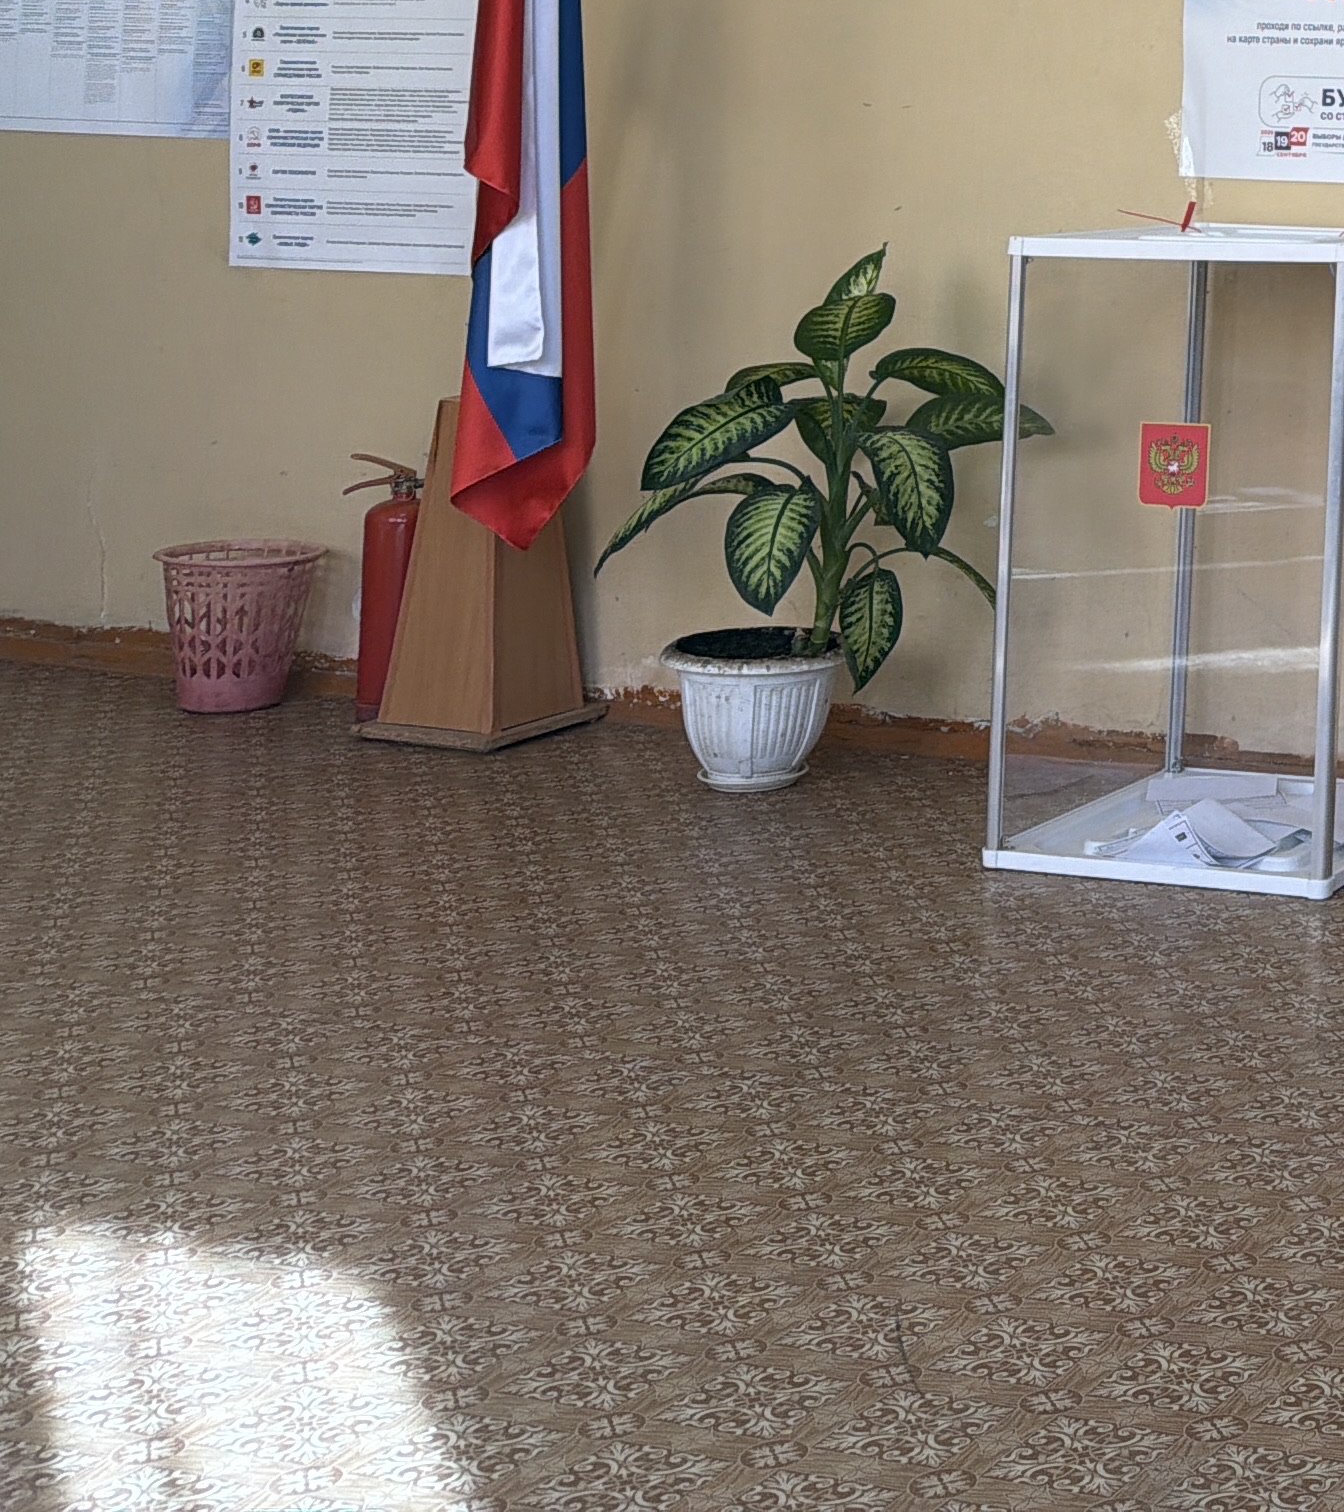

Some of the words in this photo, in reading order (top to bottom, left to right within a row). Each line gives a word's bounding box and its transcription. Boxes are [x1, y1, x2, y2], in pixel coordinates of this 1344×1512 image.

[1256, 22, 1290, 32] проходи
[1291, 23, 1302, 31] по
[1303, 24, 1335, 33] ссылке,
[1227, 35, 1237, 43] на
[1238, 36, 1261, 45] карте
[1261, 36, 1292, 46] страны
[1300, 37, 1334, 47] сохрани
[1320, 112, 1334, 122] СО
[1262, 141, 1274, 153] 18
[1276, 136, 1289, 147] 19
[1290, 131, 1306, 143] 20
